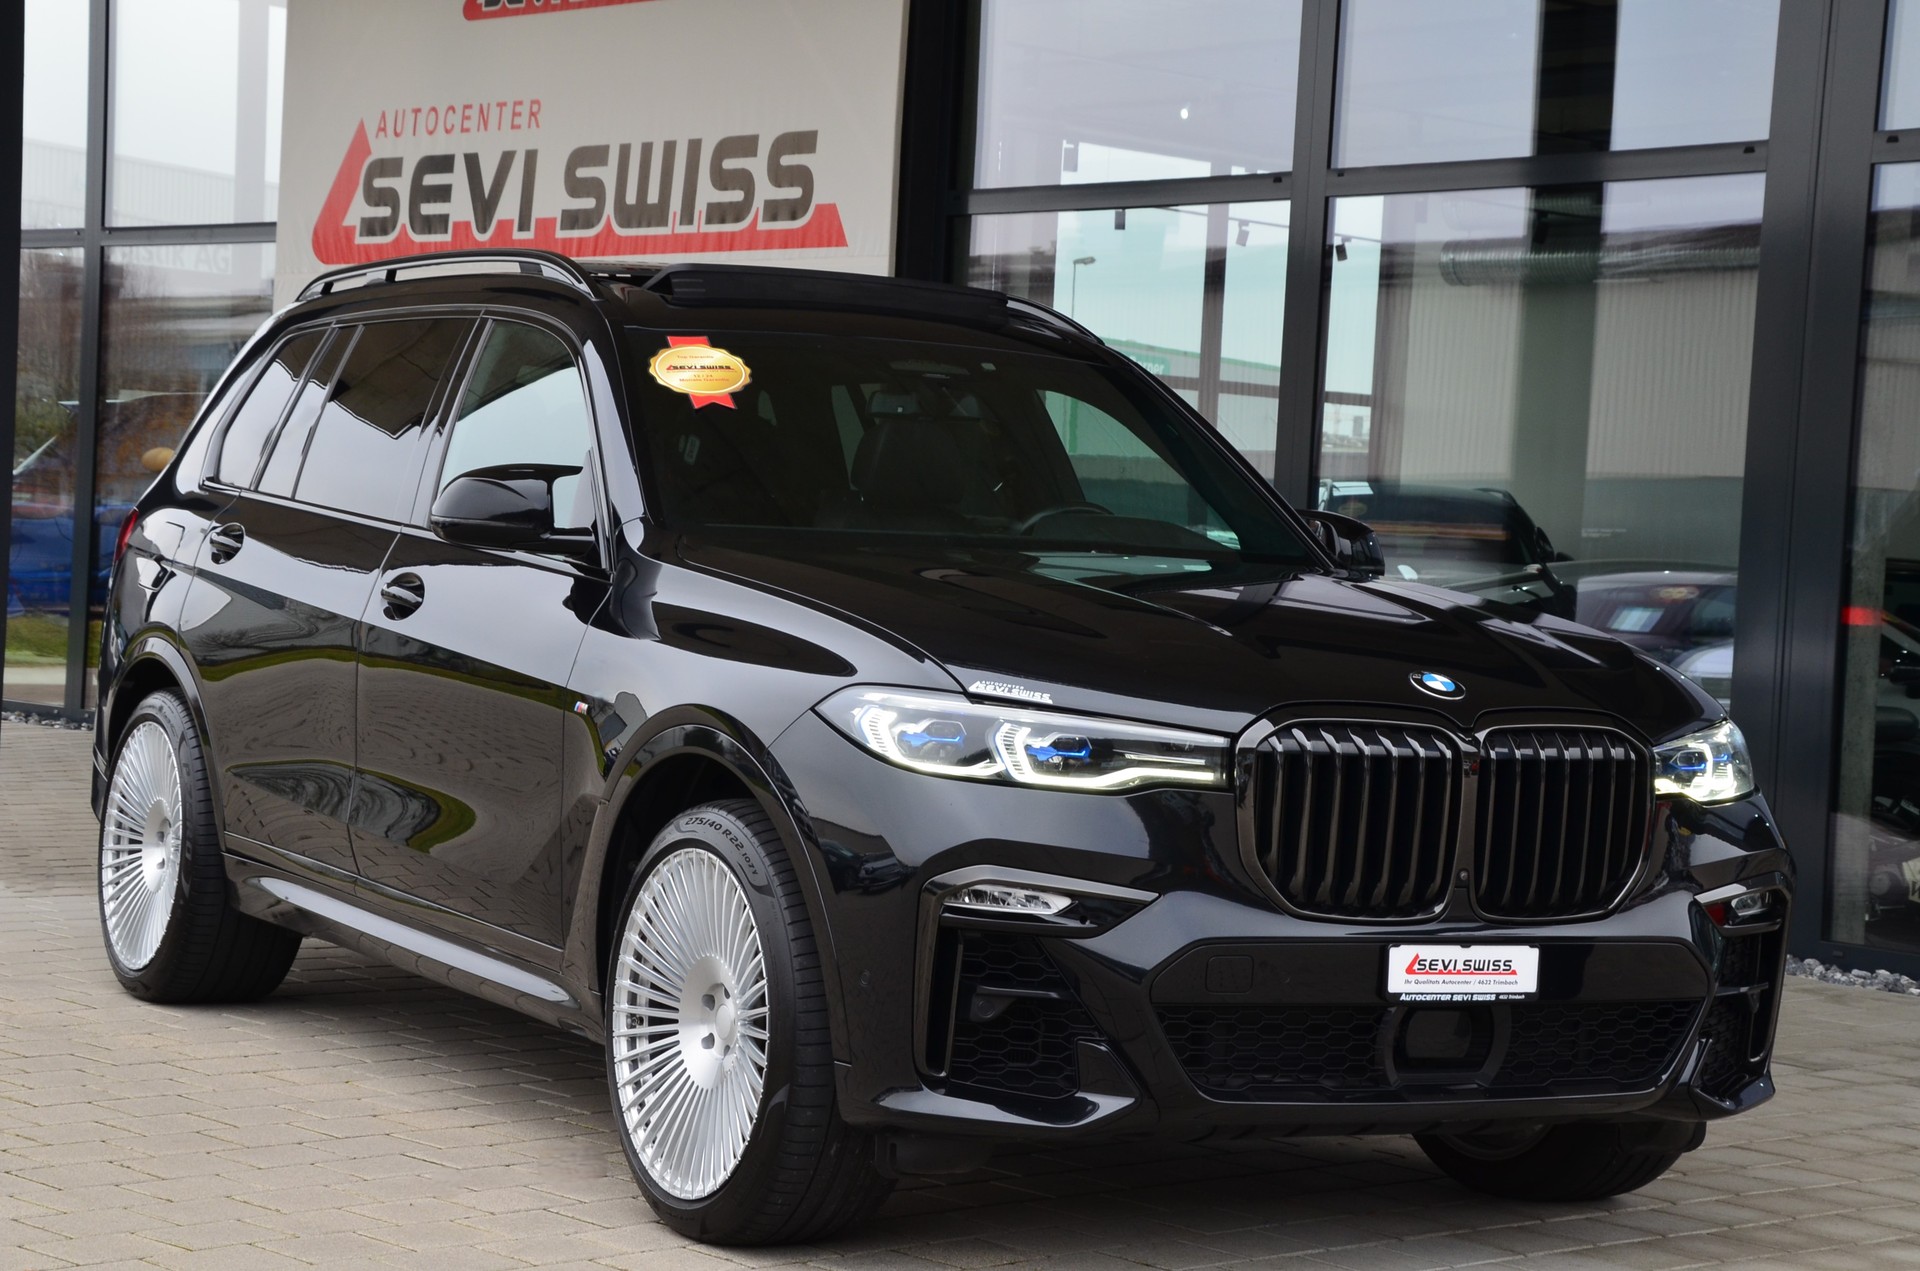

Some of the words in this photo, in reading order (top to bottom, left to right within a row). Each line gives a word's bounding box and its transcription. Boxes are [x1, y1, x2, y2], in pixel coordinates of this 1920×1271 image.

[375, 99, 543, 138] AUTOCENTER
[359, 147, 538, 237] SEVI
[559, 129, 819, 232] SWISS
[980, 684, 1010, 694] SEVI
[1011, 688, 1051, 700] SWISS
[981, 681, 1025, 690] AUTOCENTER
[684, 817, 723, 831] 275/40
[1417, 959, 1458, 971] SEVI
[1462, 959, 1512, 972] SWISS
[1400, 993, 1452, 1001] AUTOCENTER
